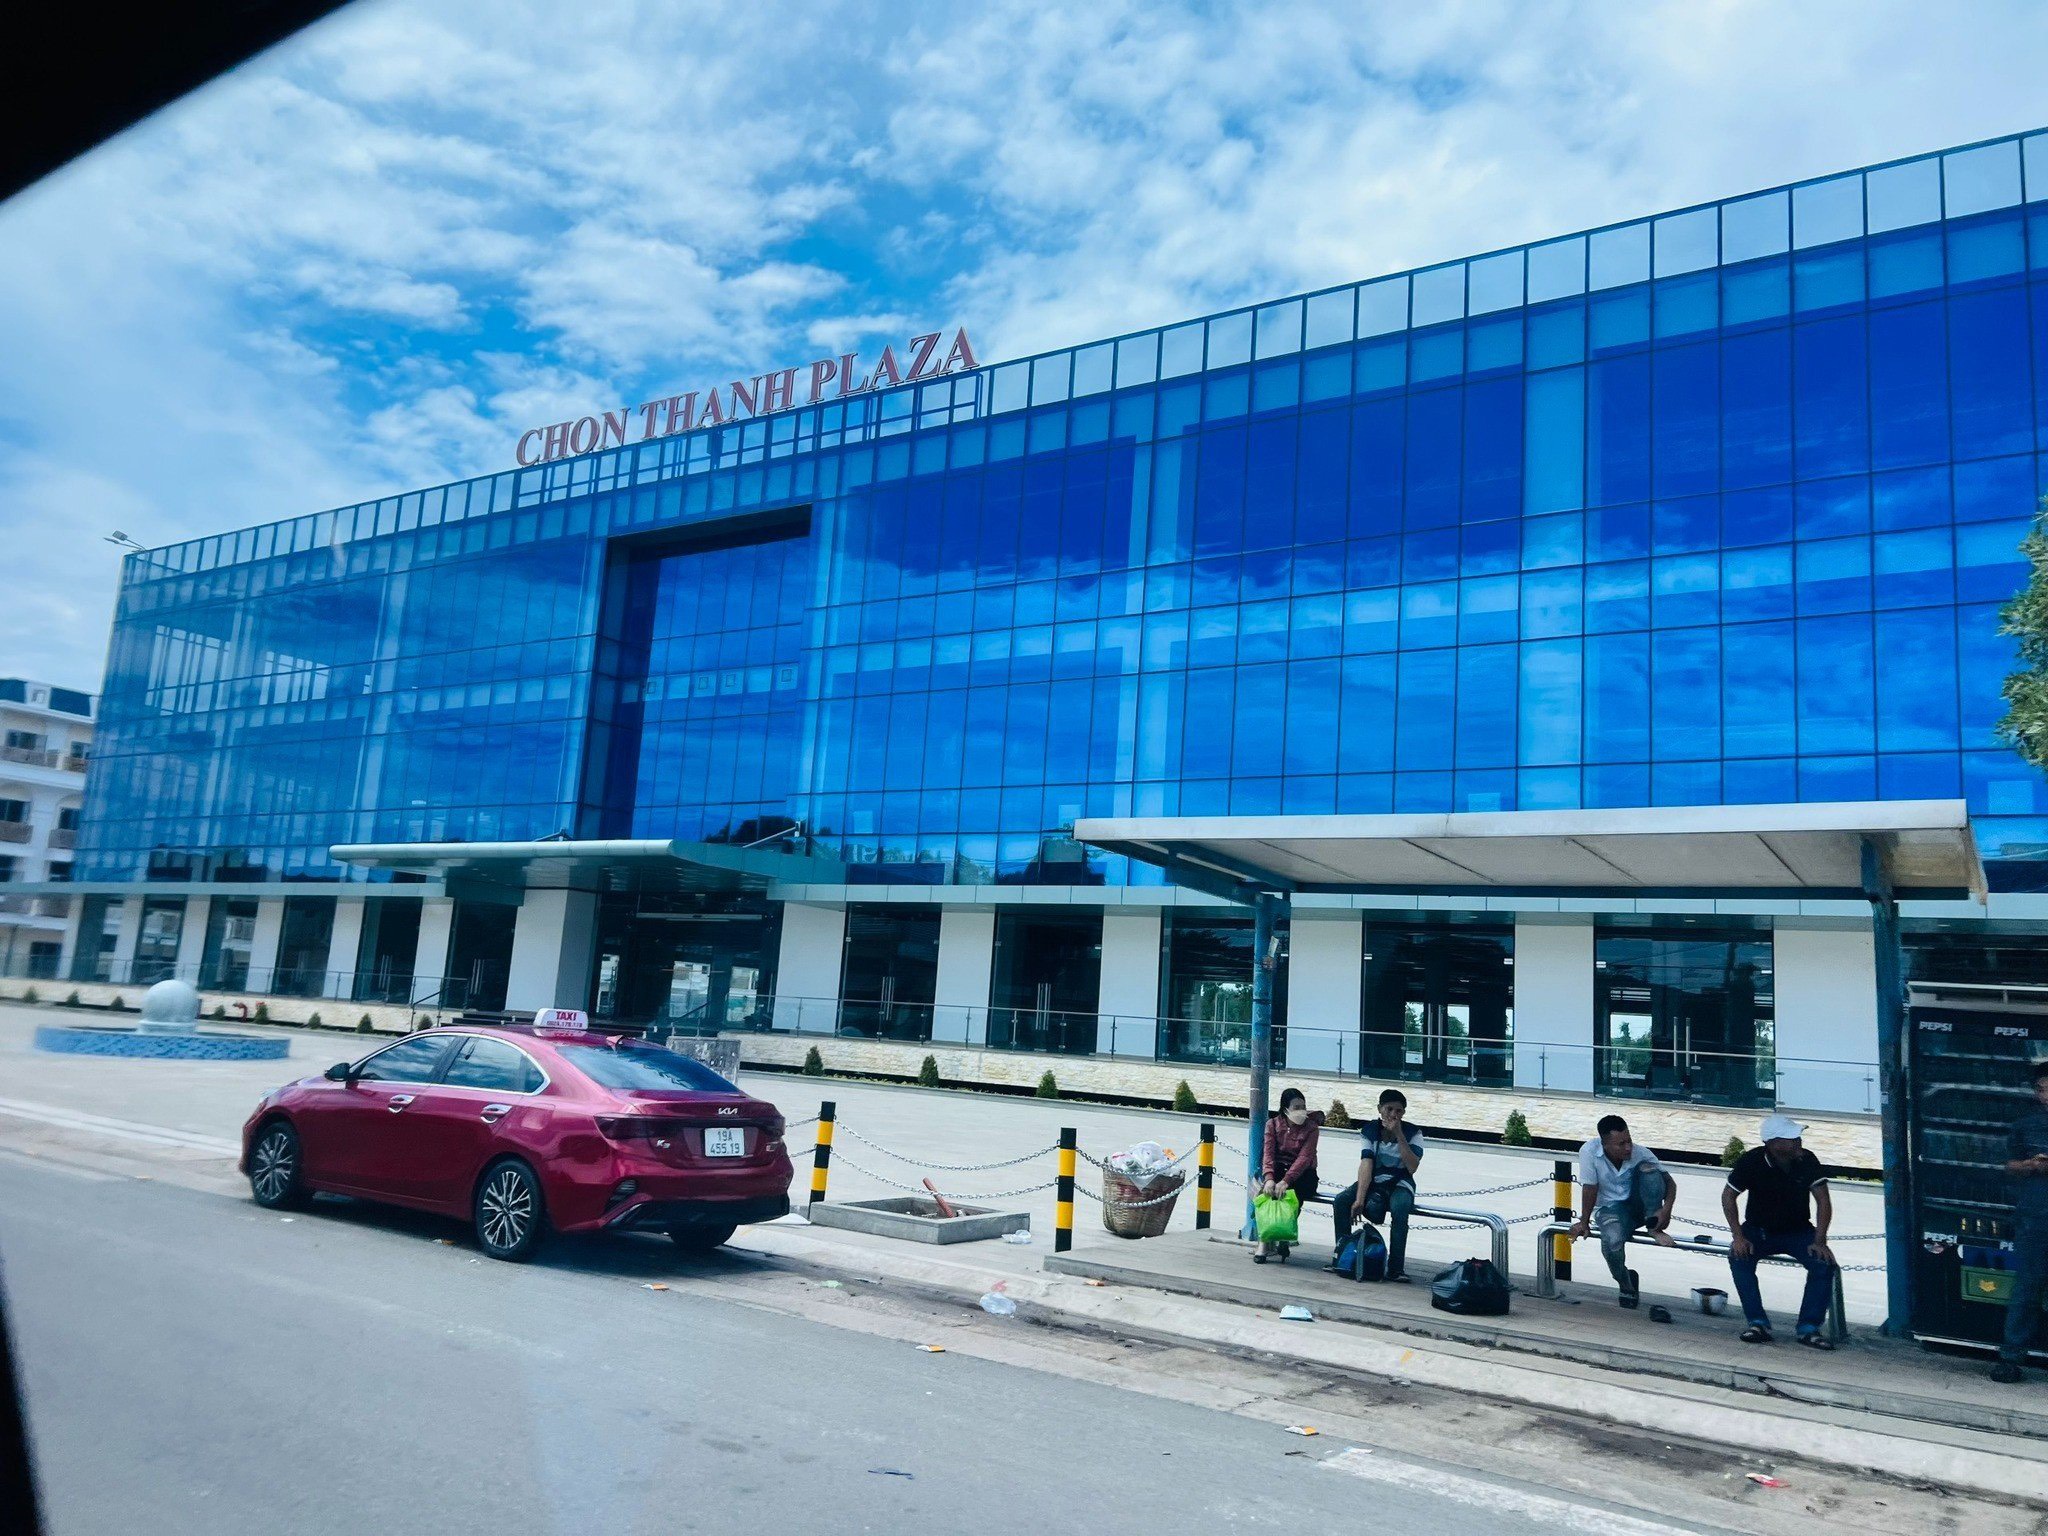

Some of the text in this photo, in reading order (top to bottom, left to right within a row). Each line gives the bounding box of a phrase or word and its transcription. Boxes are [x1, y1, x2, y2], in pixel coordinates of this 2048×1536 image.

[516, 326, 980, 466] CHON THANH PLAZA
[556, 1011, 577, 1021] TAXI
[718, 1107, 738, 1115] KIA
[717, 1131, 733, 1142] 19A
